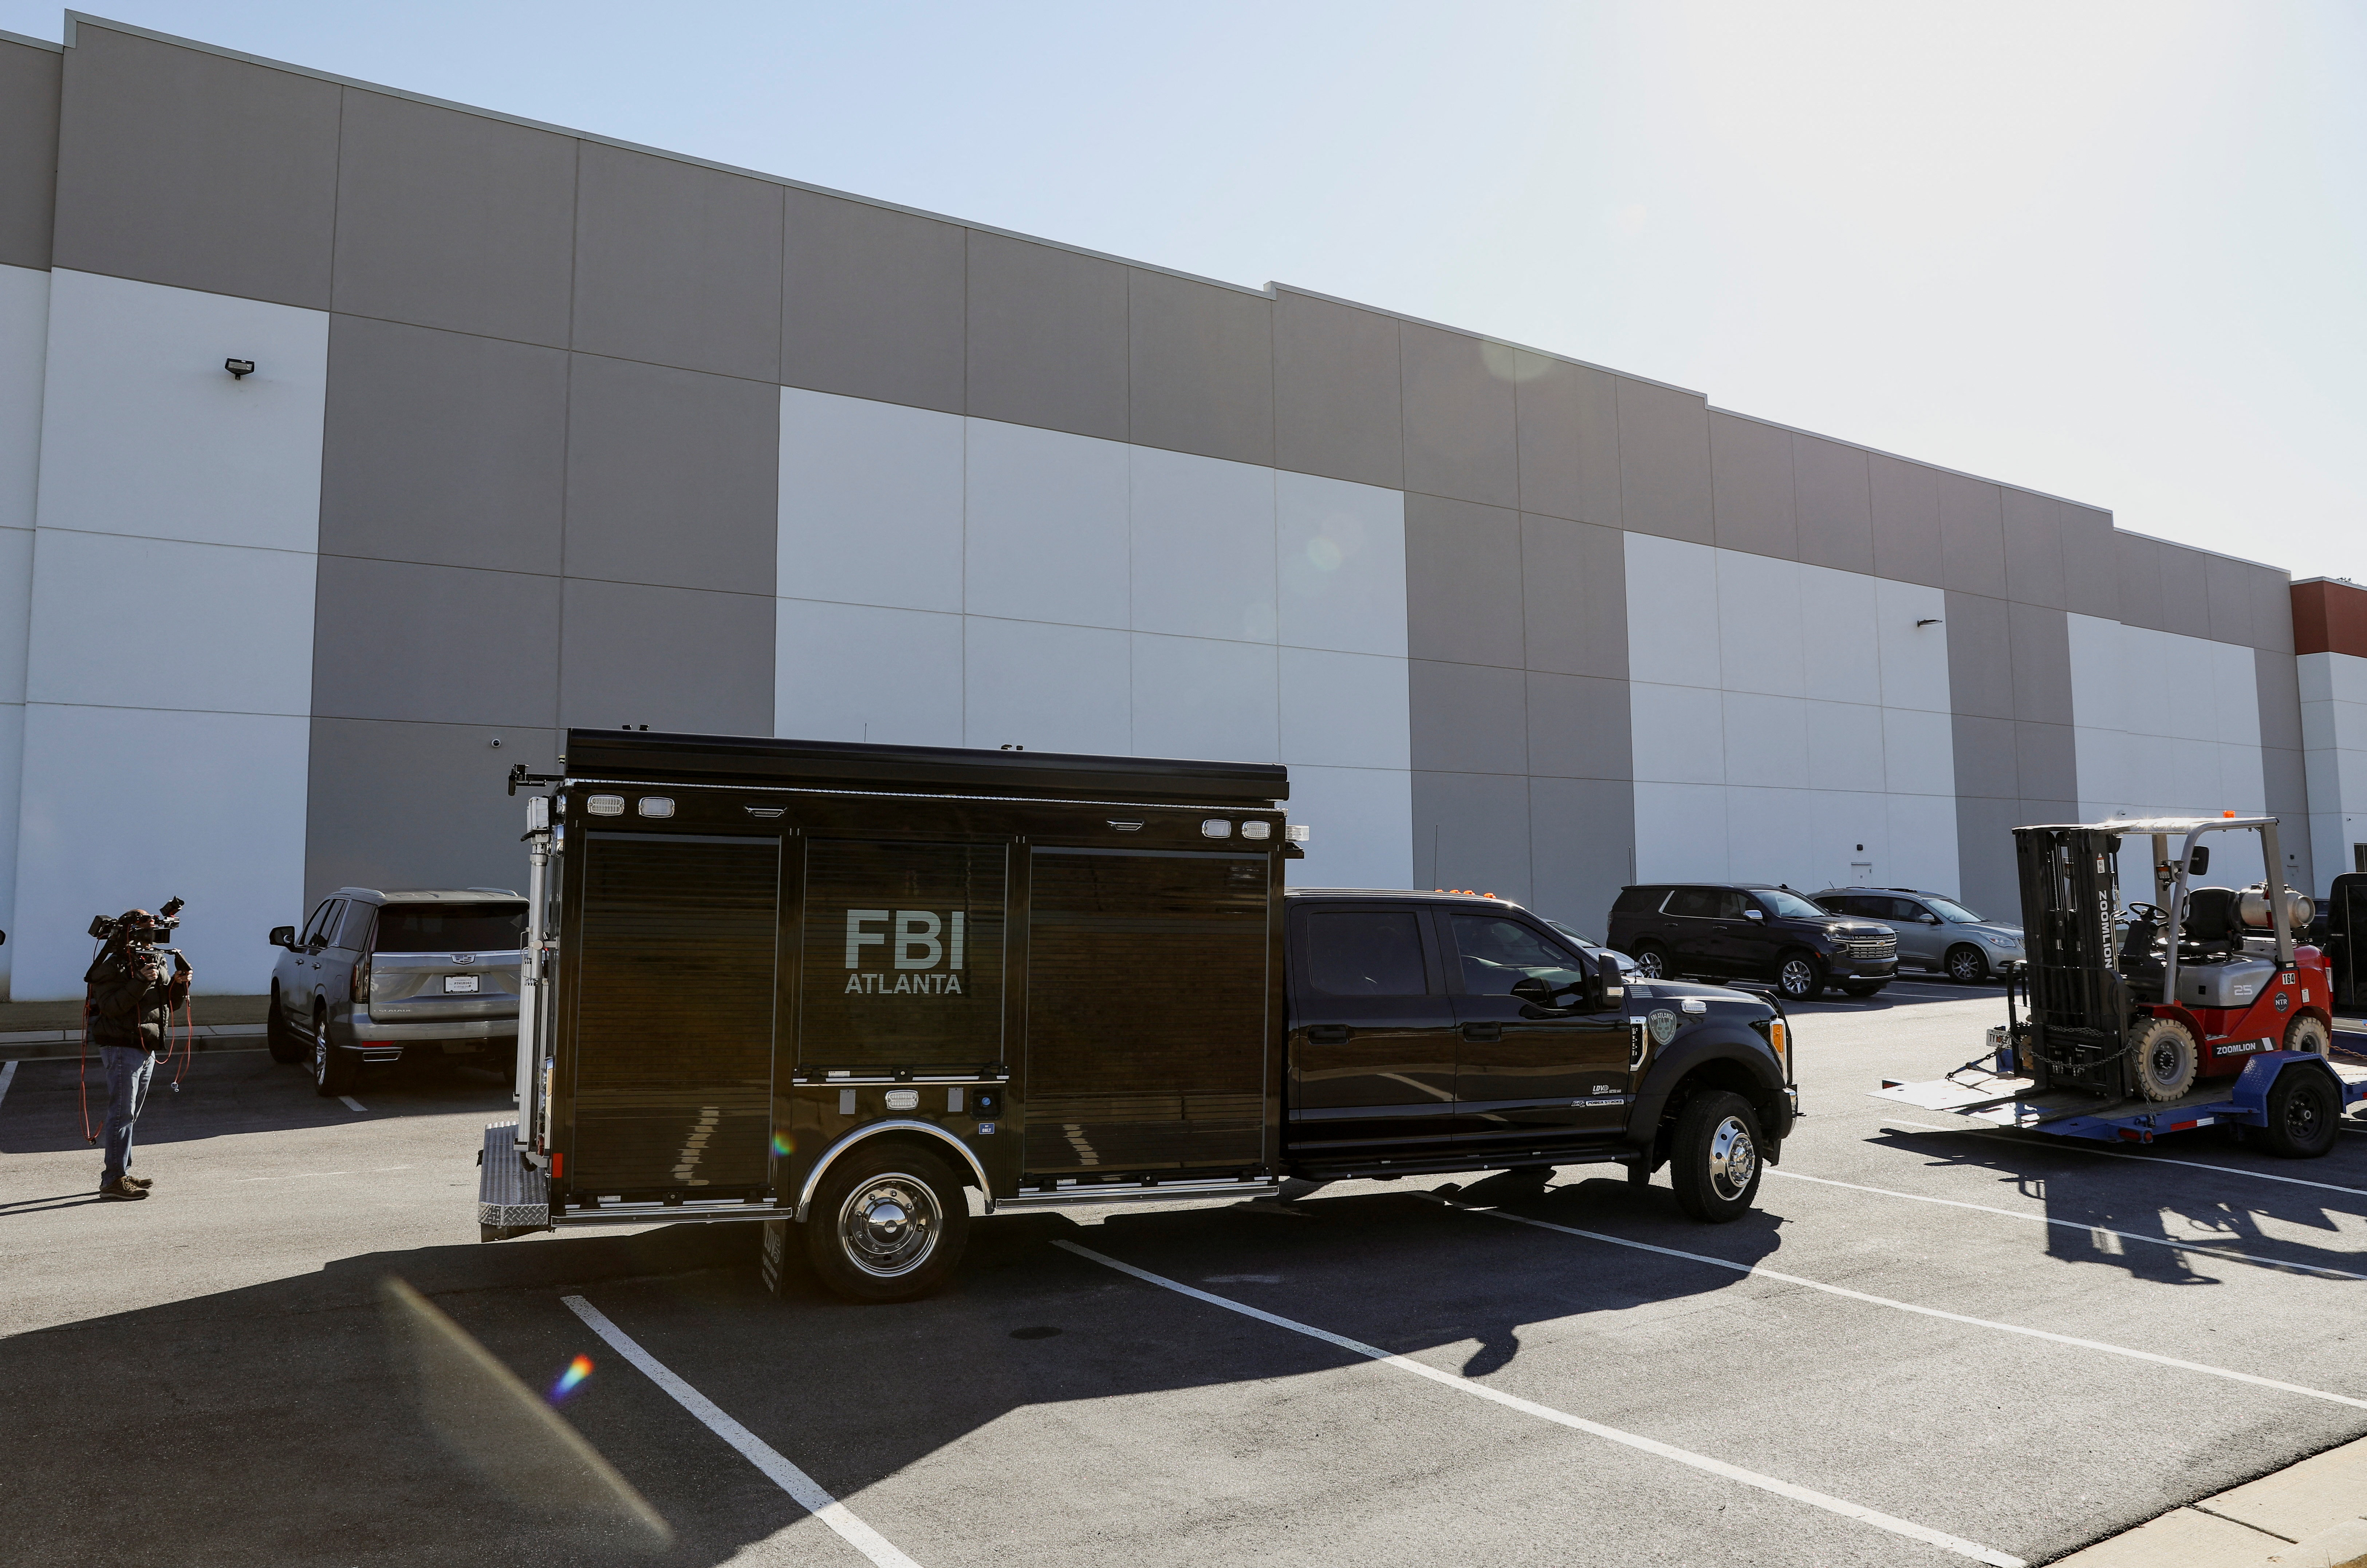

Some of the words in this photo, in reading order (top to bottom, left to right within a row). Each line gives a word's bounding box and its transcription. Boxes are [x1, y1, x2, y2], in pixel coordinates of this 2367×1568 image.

[2099, 890, 2112, 968] ZOOMLION
[845, 909, 964, 969] FBI
[844, 973, 962, 994] ATLANTA
[2284, 974, 2294, 984] 164
[2234, 985, 2253, 995] 25
[1657, 1012, 1673, 1020] ATLANTA
[2217, 1043, 2256, 1055] ZOOMLION
